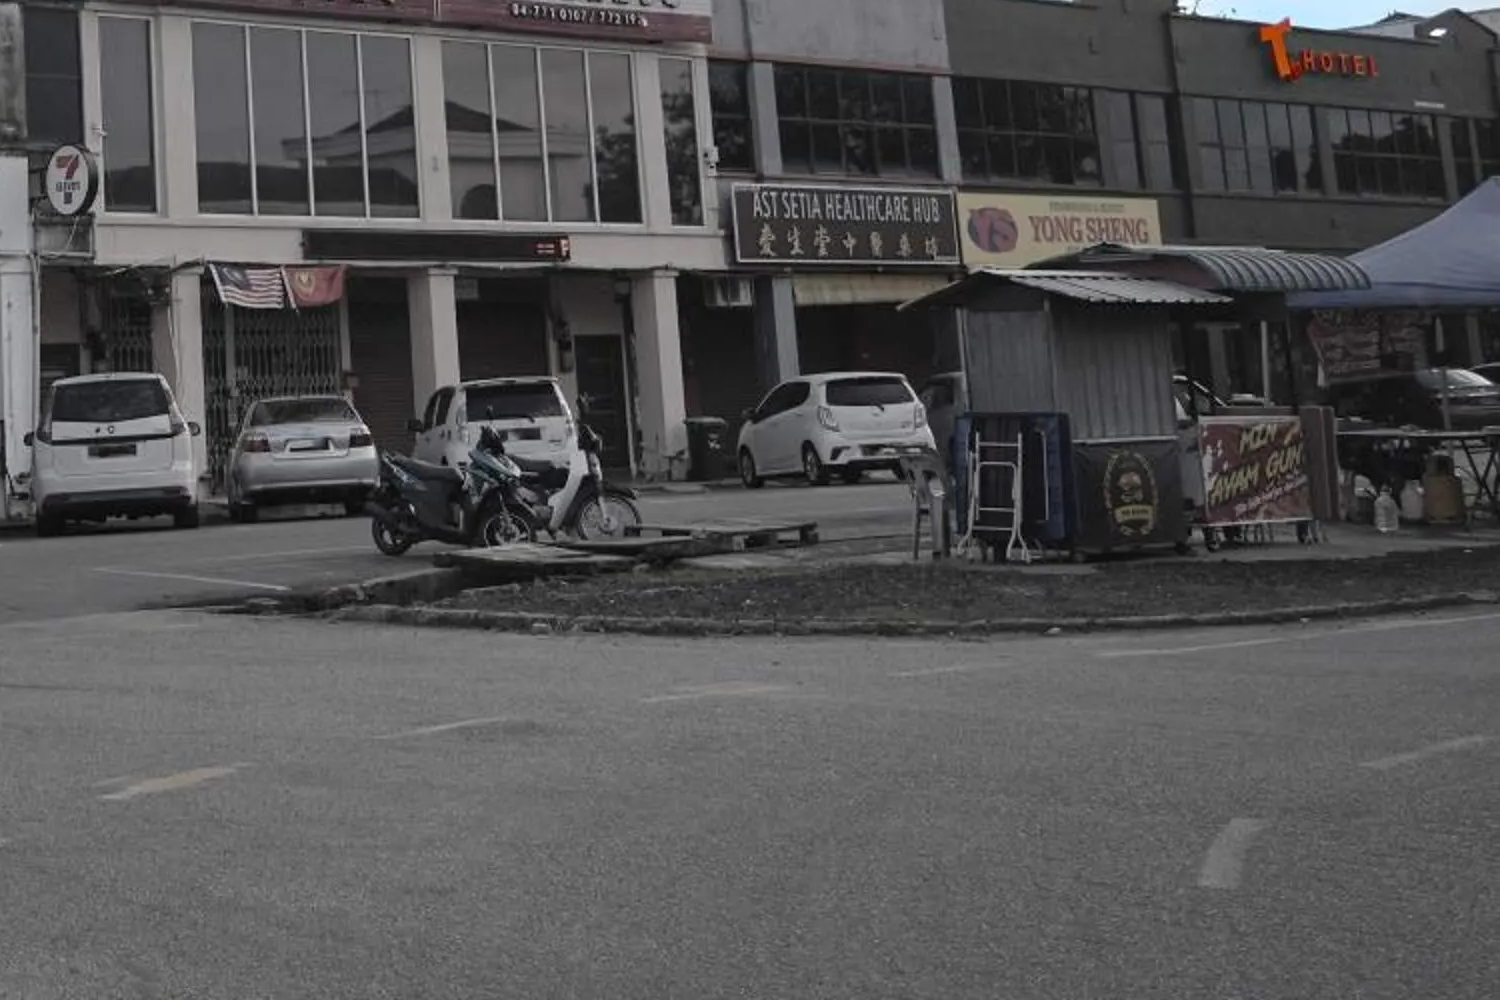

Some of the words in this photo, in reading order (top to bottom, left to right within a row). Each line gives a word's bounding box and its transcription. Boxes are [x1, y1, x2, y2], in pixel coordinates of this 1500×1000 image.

[1303, 49, 1378, 77] HOTEL
[753, 191, 778, 218] AST
[781, 191, 822, 219] SETIA
[825, 193, 911, 222] HEALTHCARE
[913, 196, 940, 223] HUB
[1028, 215, 1083, 243] YONG
[1085, 216, 1148, 244] SHENG
